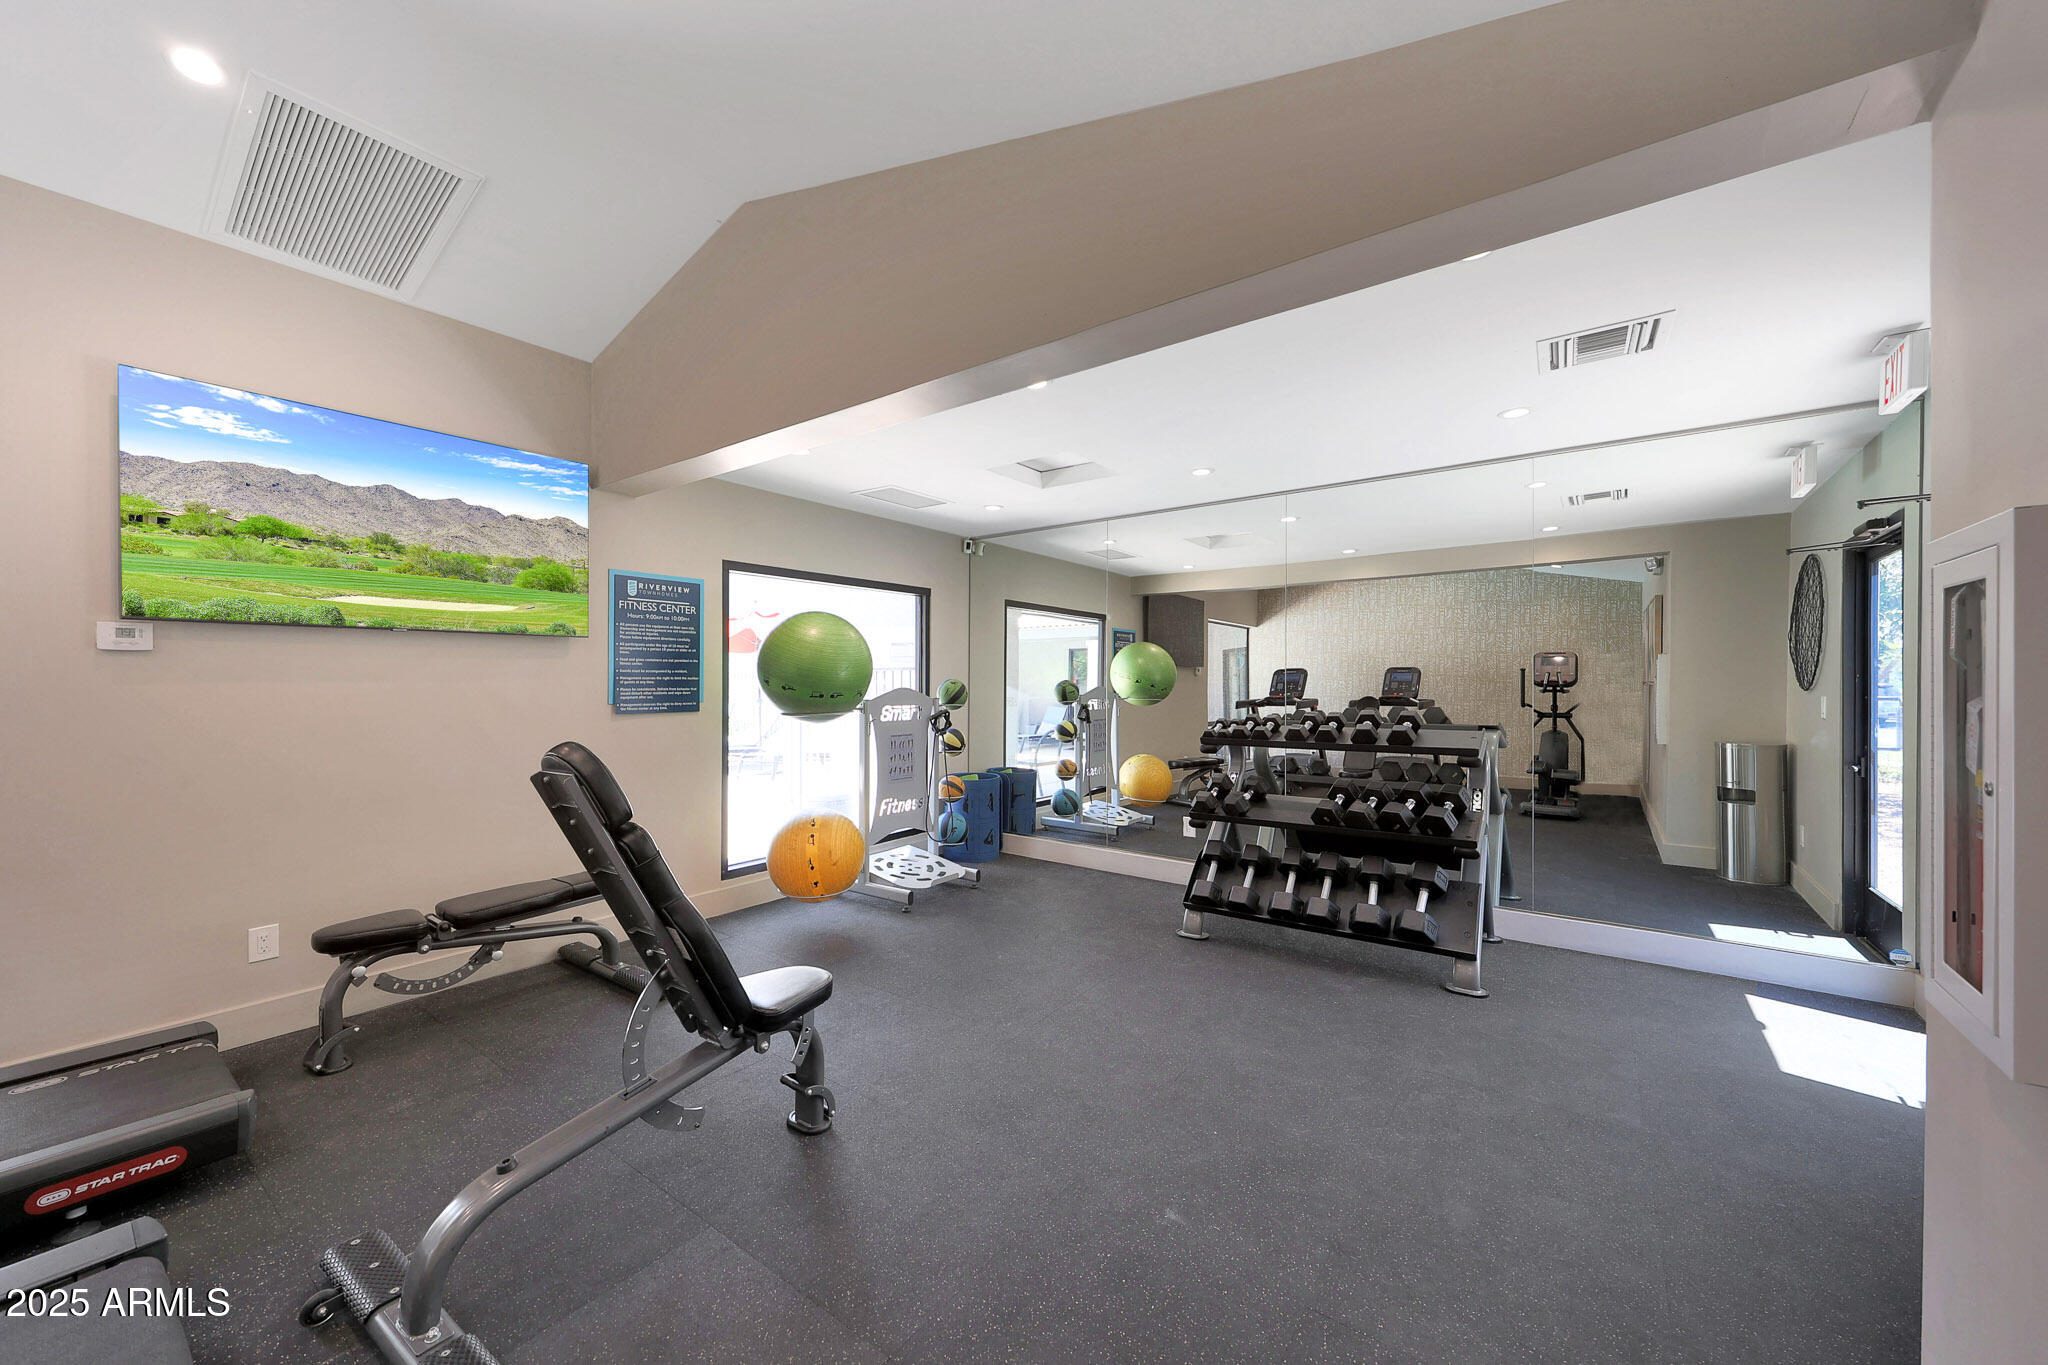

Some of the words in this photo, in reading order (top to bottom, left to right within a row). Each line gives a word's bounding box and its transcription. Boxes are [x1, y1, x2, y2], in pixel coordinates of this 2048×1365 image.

[1884, 343, 1905, 405] EXIT
[638, 582, 690, 594] RIVERVIEW
[638, 589, 678, 598] TOWNHOMES
[619, 600, 657, 613] FITNESS
[659, 603, 697, 615] CENTER
[880, 704, 922, 722] Smart
[879, 797, 924, 817] Fitness
[78, 1053, 160, 1078] STAR
[74, 1170, 127, 1194] STAR
[128, 1154, 178, 1176] TRAC
